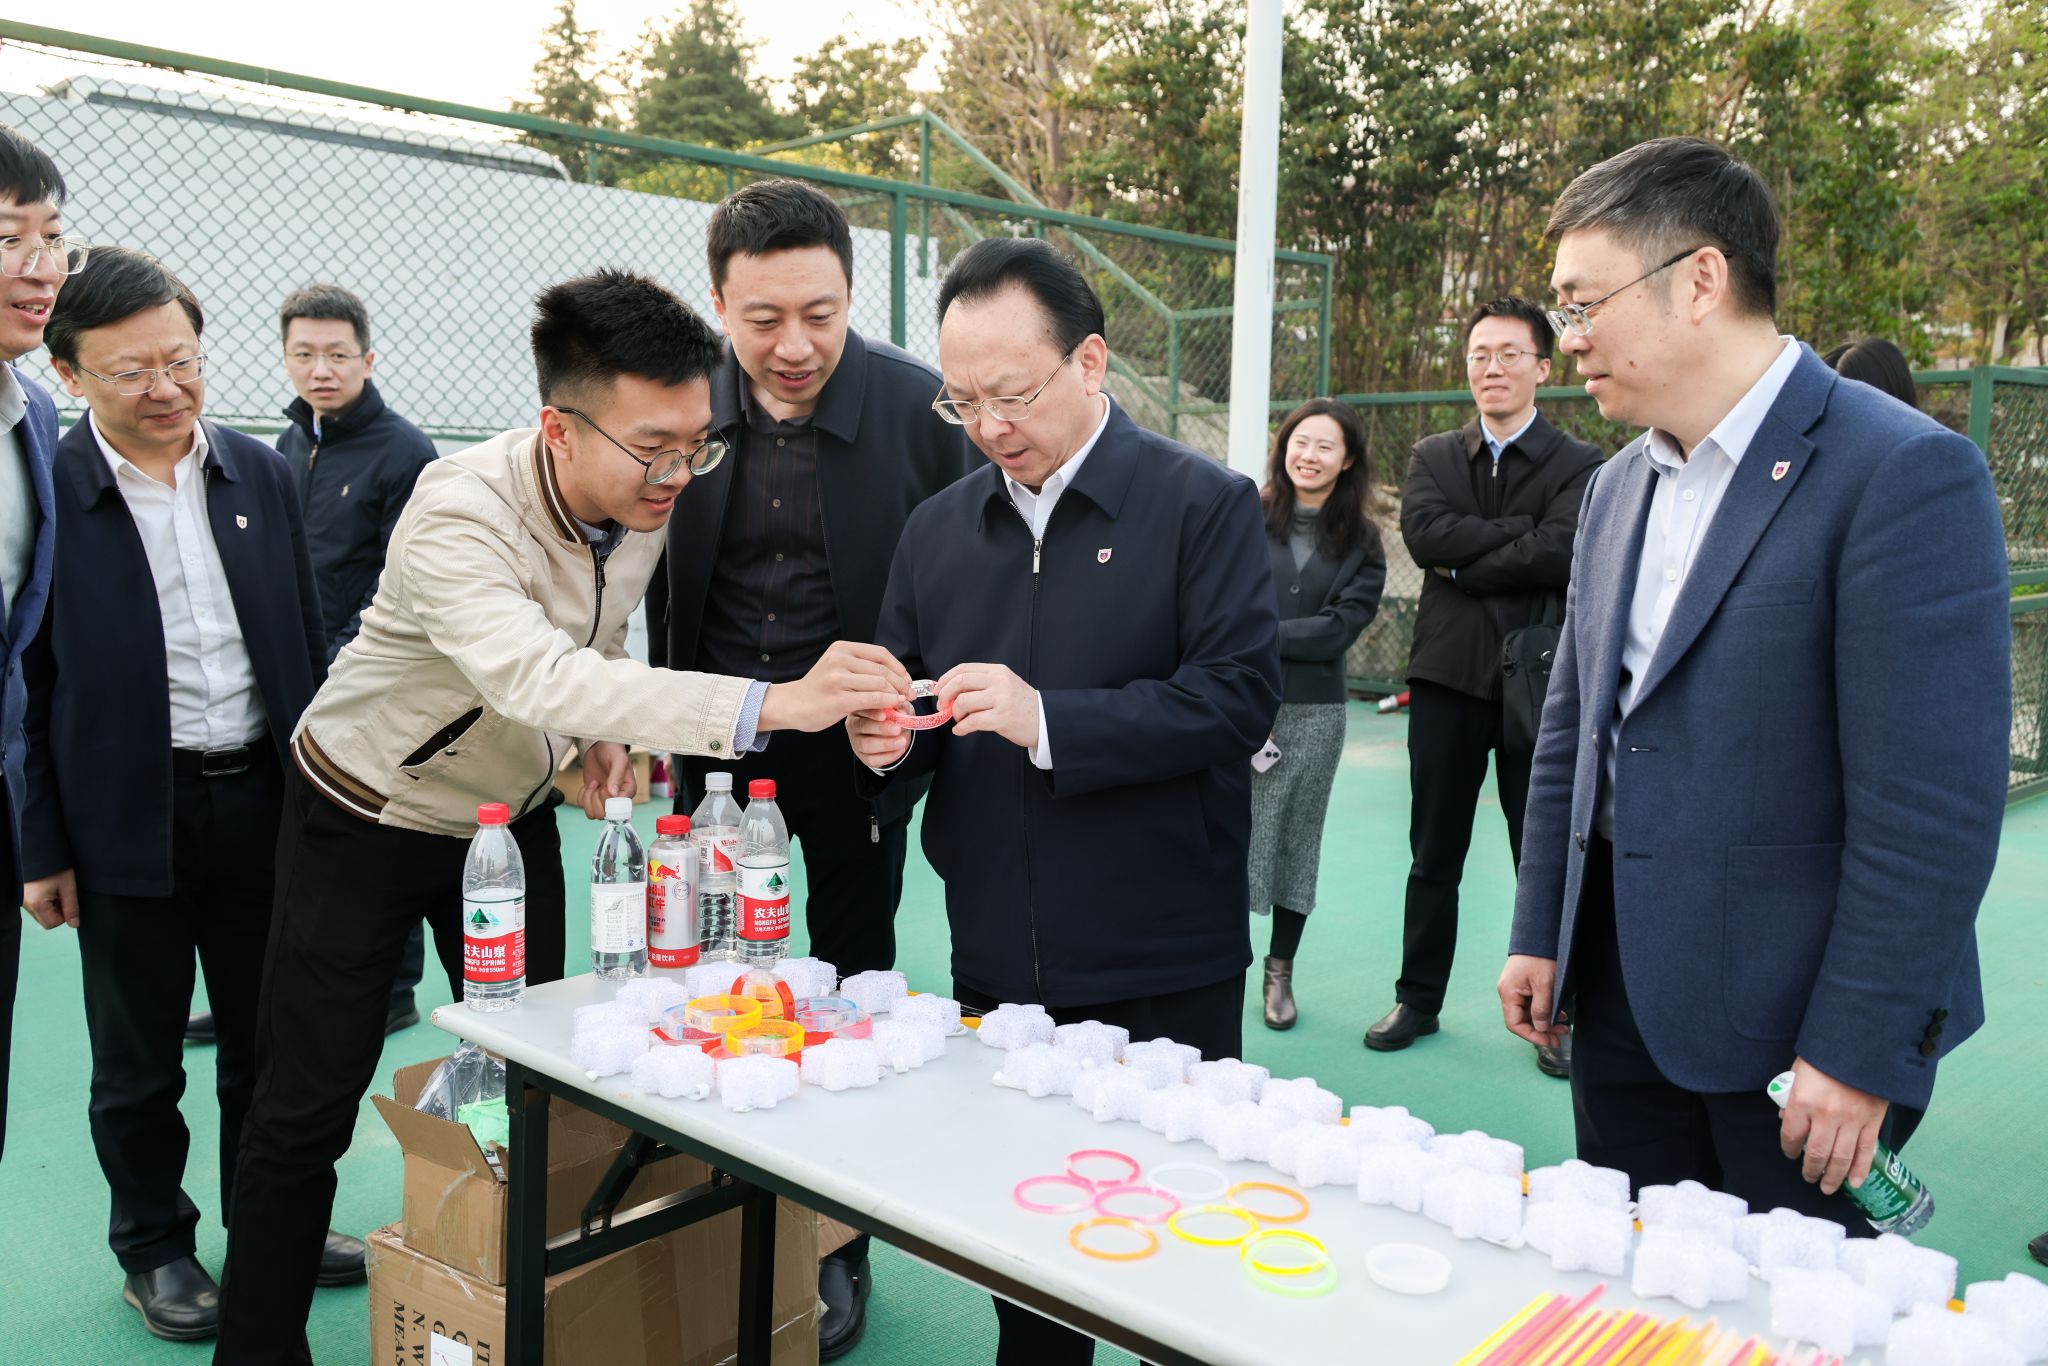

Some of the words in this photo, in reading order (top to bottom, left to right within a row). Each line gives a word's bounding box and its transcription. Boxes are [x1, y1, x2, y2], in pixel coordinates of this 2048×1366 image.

[754, 918, 777, 926] NONGFU
[648, 952, 676, 963] 能量饮料
[481, 958, 506, 967] SPRING
